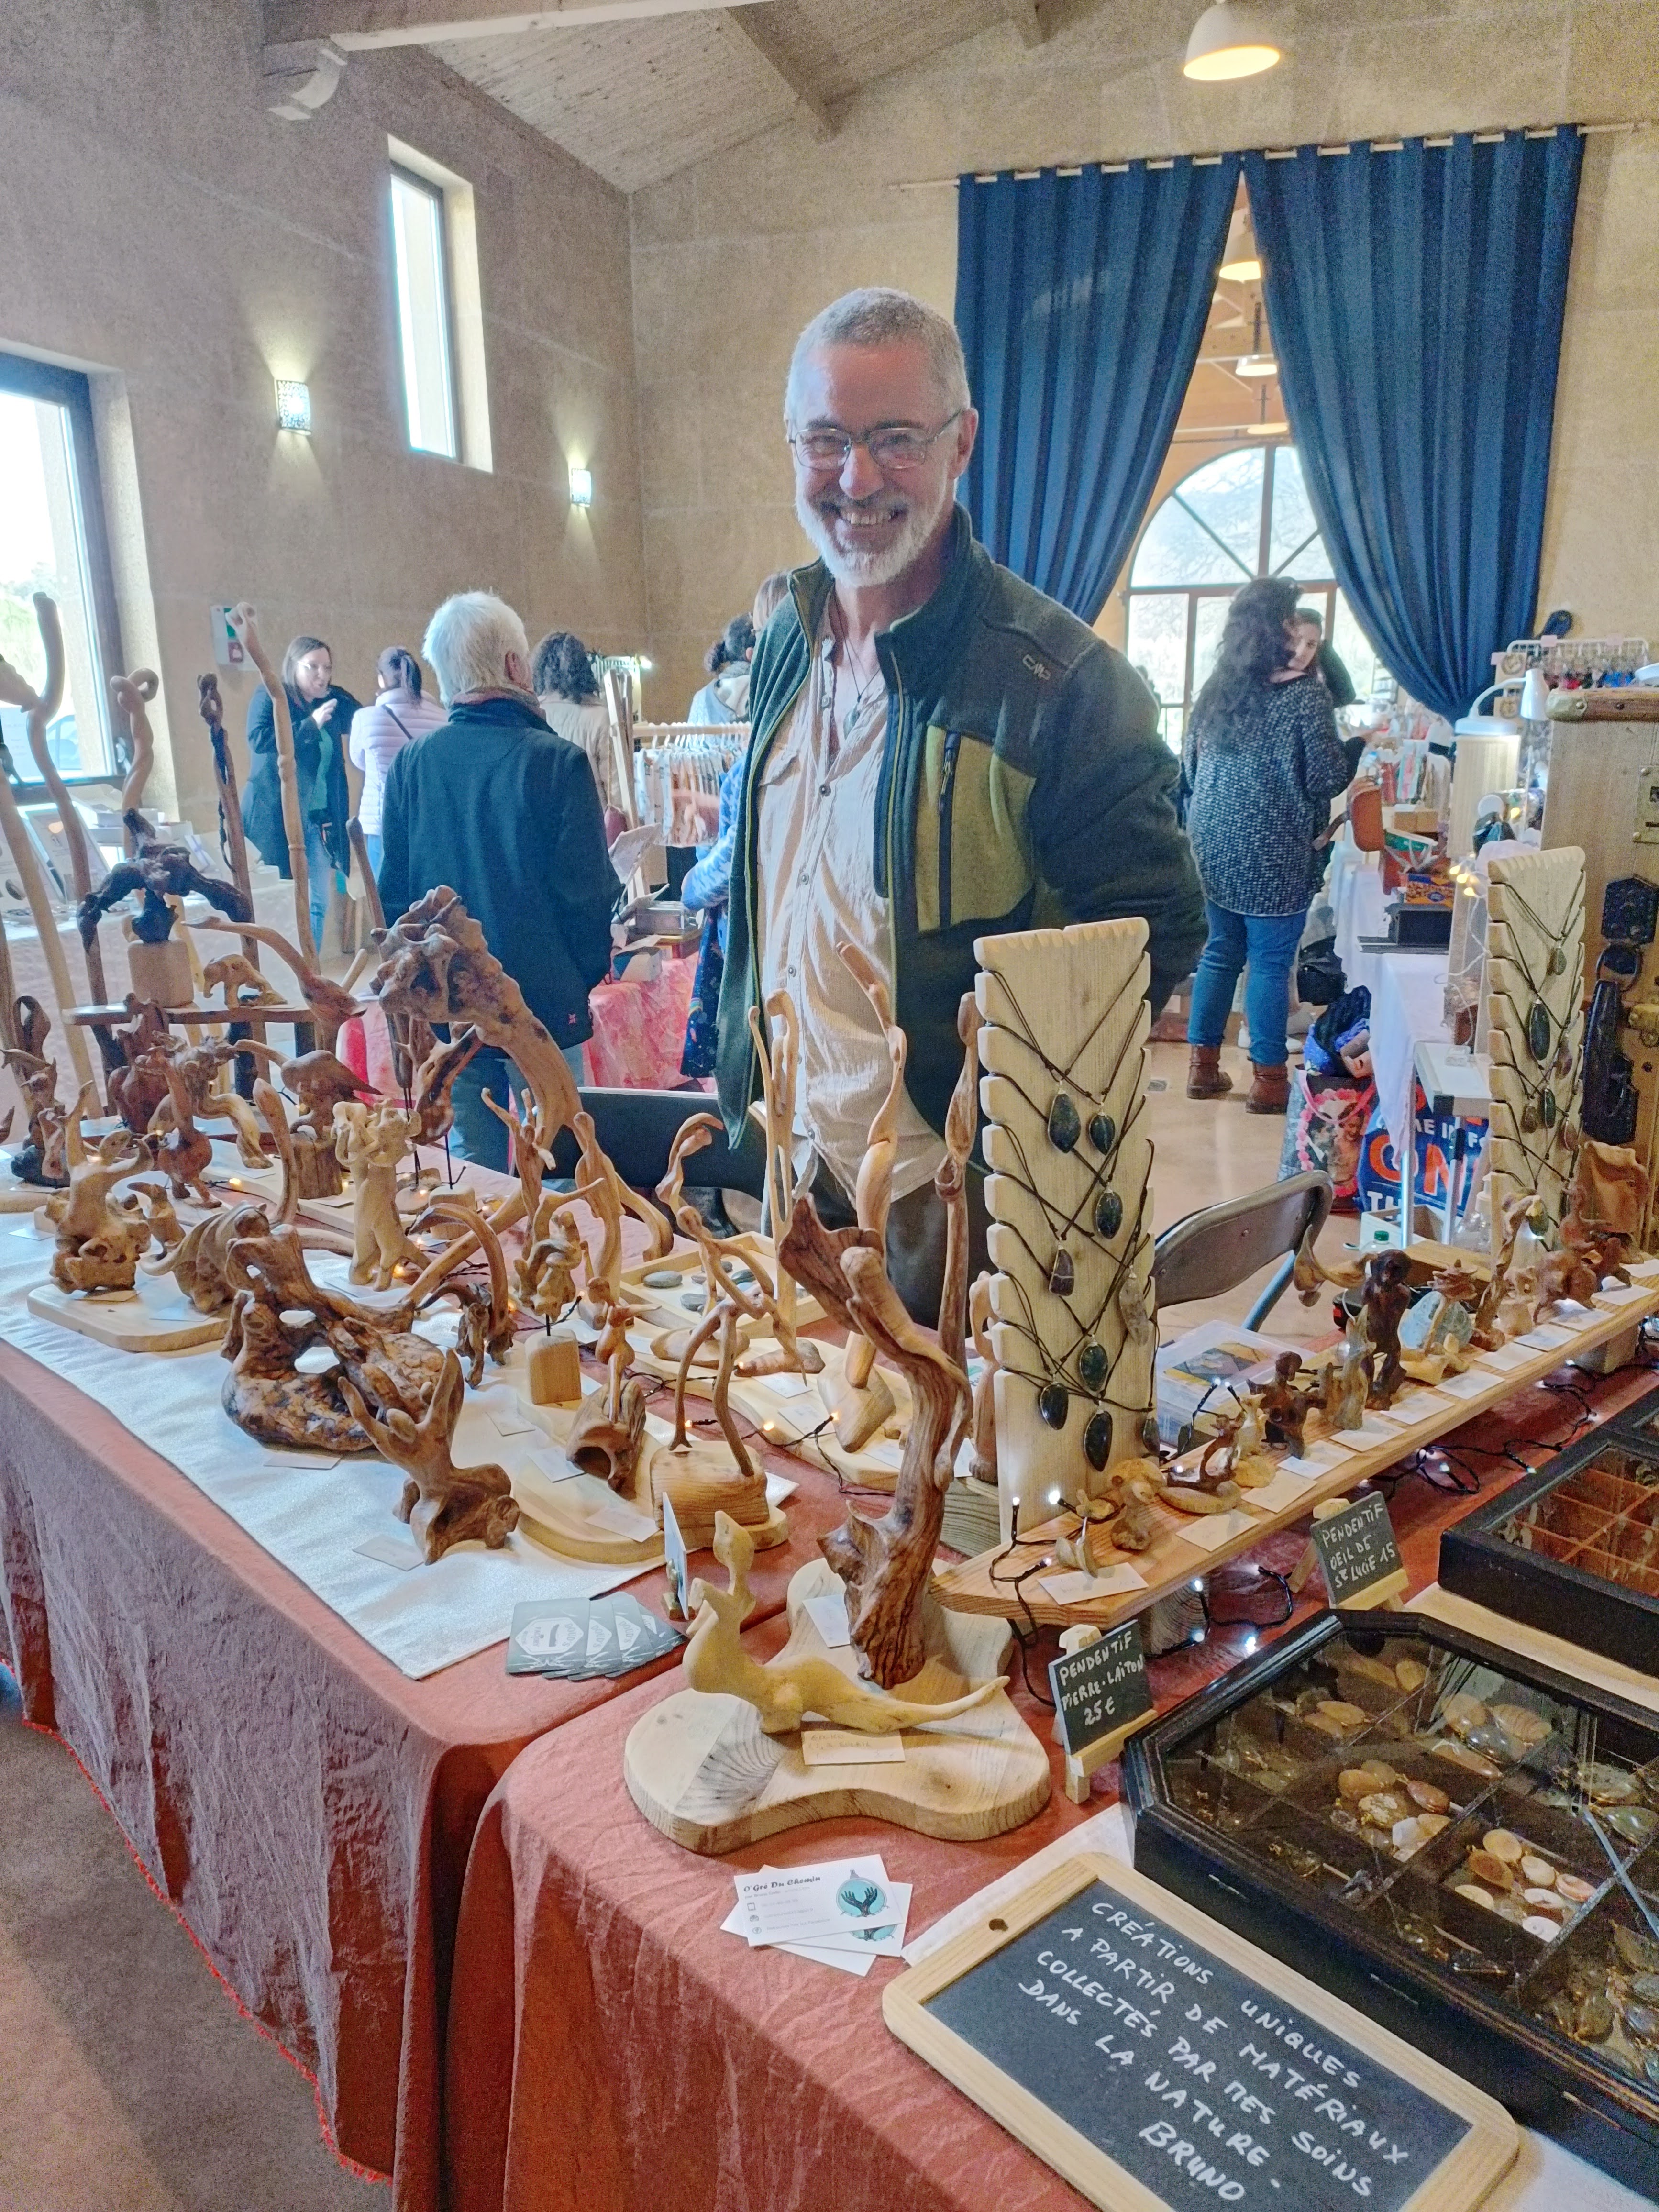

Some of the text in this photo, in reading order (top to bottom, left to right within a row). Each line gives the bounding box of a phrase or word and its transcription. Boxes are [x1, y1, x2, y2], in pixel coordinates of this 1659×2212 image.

[1355, 1534, 1372, 1553] DE
[787, 1876, 821, 1886] Chemin
[1018, 1979, 1081, 2025] DANS
[1095, 2034, 1135, 2066] LA
[1185, 2003, 1228, 2034] DE
[1168, 2036, 1217, 2083] PAR
[1139, 2121, 1245, 2201] BRUNO
